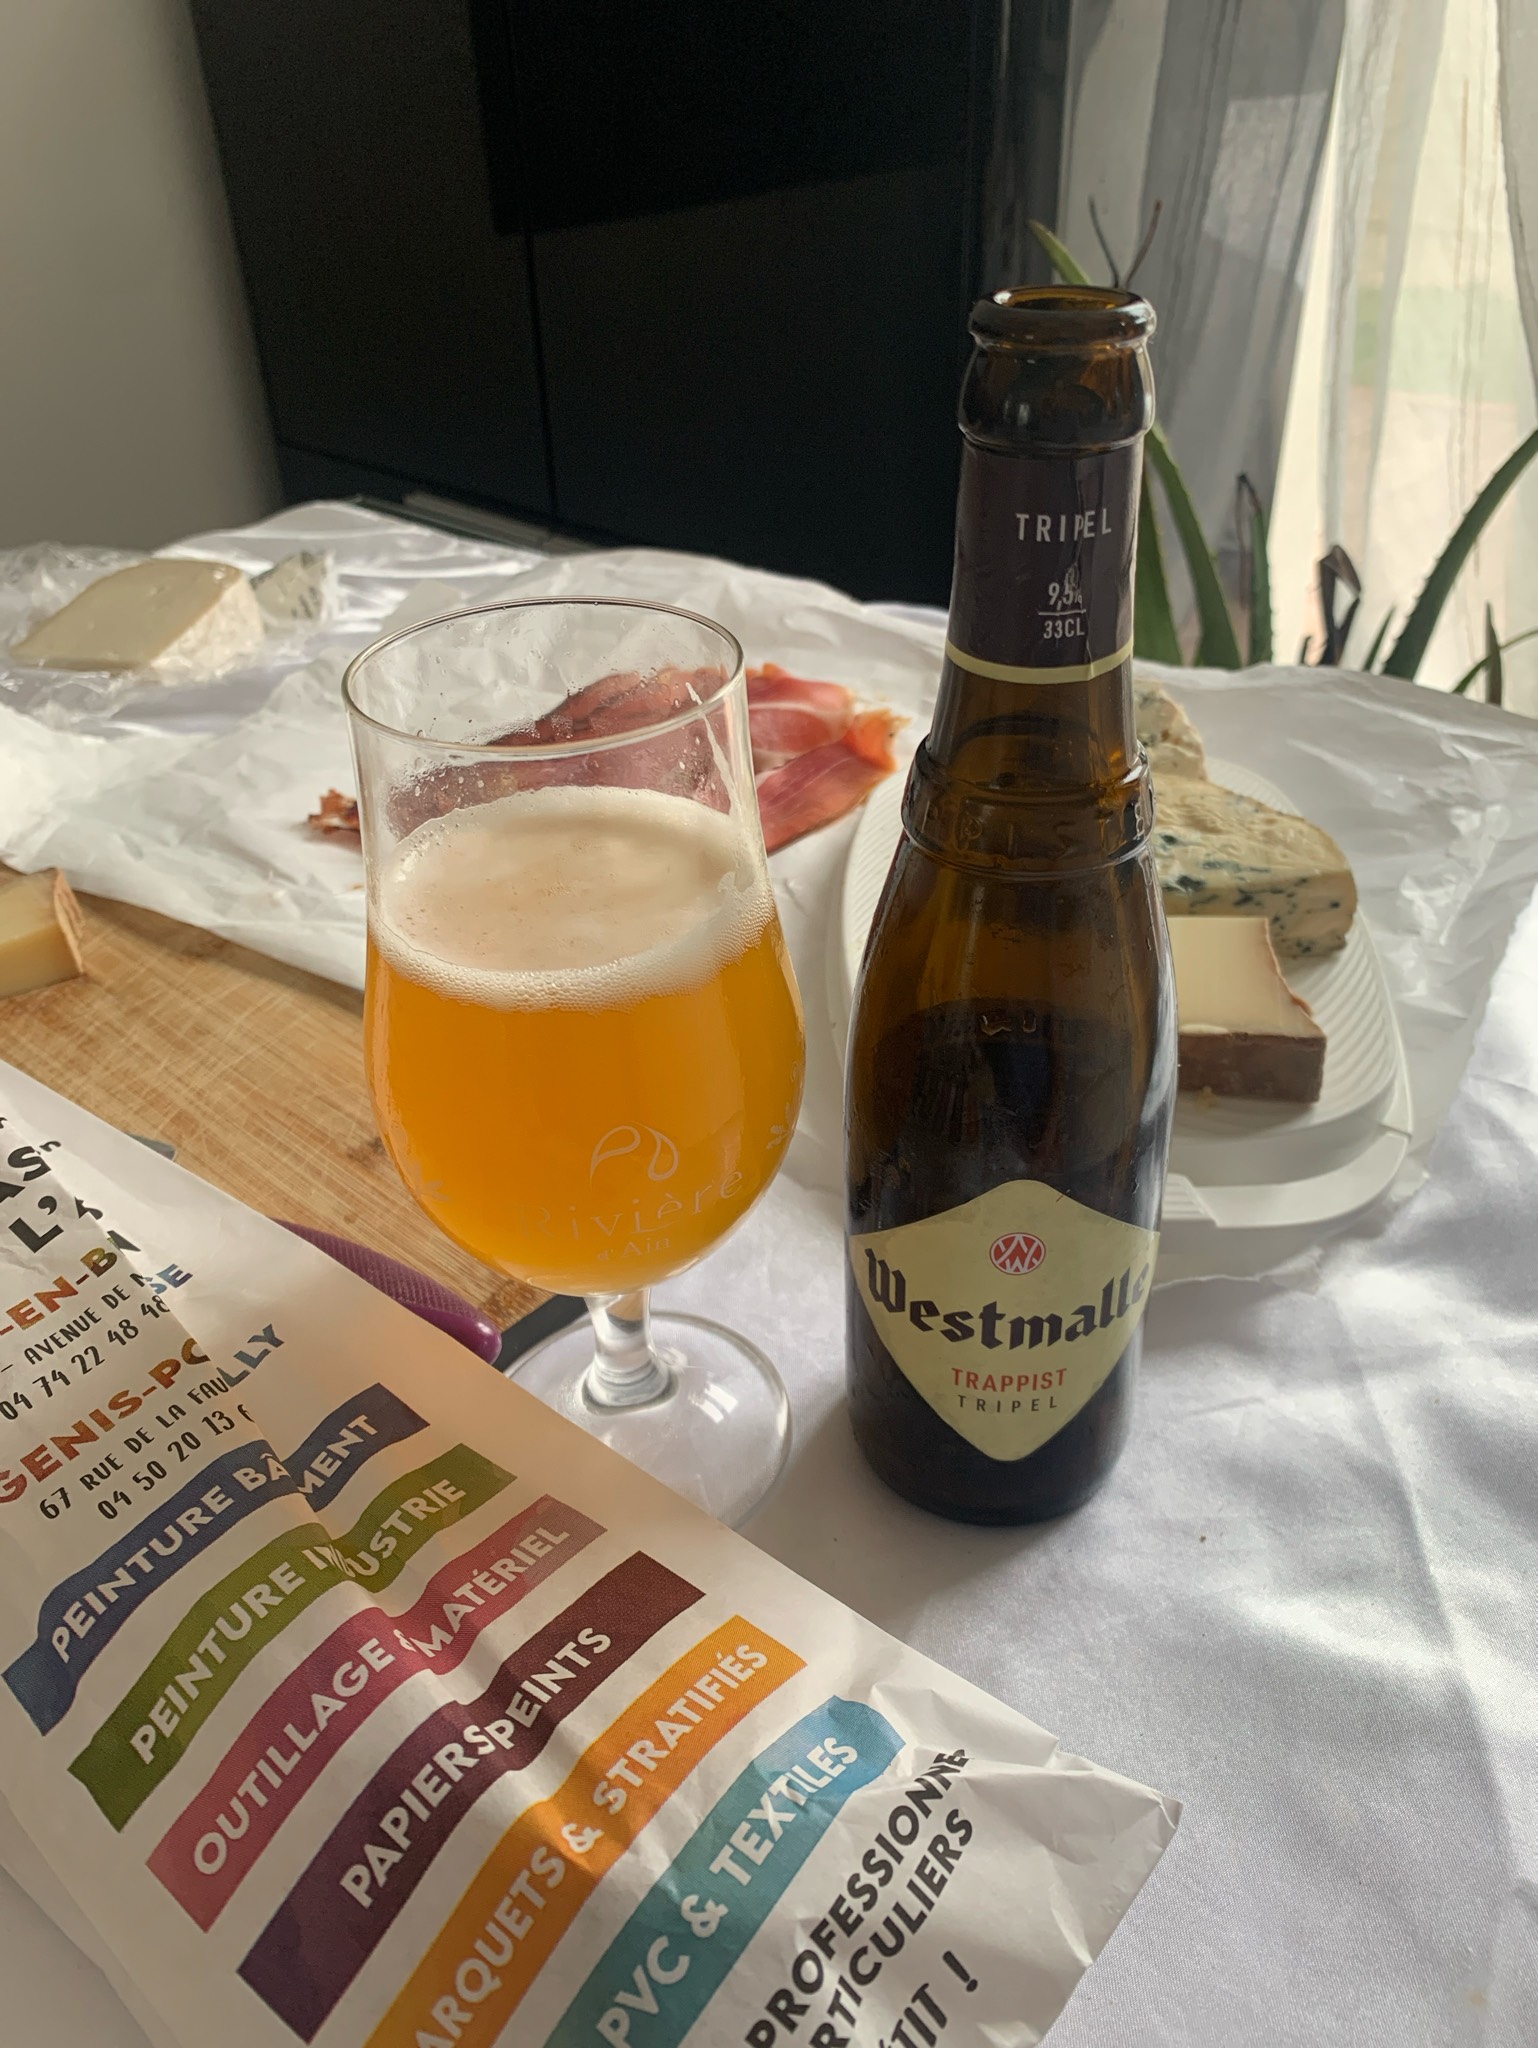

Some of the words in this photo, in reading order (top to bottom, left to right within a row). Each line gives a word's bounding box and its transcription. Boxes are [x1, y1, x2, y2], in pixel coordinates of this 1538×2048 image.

[1015, 508, 1112, 543] TRIPEL
[1043, 618, 1085, 639] 33CL
[520, 1170, 744, 1241] Rivière
[0, 1391, 33, 1421] 04
[32, 1369, 71, 1398] 74
[71, 1345, 105, 1375] 22
[107, 1319, 139, 1346] 48
[140, 1295, 170, 1320] 48
[24, 1307, 102, 1365] AVENUE
[101, 1284, 130, 1309] DE
[864, 1247, 1151, 1351] Westmalle
[951, 1367, 1067, 1393] TRAPPIST
[957, 1395, 1058, 1413] TRIPEL
[39, 1486, 72, 1519] 67
[80, 1453, 124, 1491] RUE
[124, 1427, 155, 1454] DE
[156, 1404, 187, 1428] LA
[187, 1376, 229, 1405] FAU
[97, 1490, 132, 1520] 04
[132, 1460, 167, 1491] 50
[167, 1431, 201, 1463] 20
[202, 1409, 235, 1436] 13
[52, 1484, 236, 1664] PEINTURE
[129, 1561, 306, 1765] PEINTURE
[193, 1636, 397, 1875] OUTILLAGE
[409, 1524, 570, 1658] MATÉRIEL
[340, 1722, 496, 1910] PAPIERS
[479, 1626, 613, 1751] PEINTS
[415, 1846, 566, 2048] ARQUETS
[561, 1823, 605, 1854] &
[593, 1643, 769, 1816] STRATIFIÉS
[595, 1935, 691, 2048] PVC
[681, 1894, 729, 1939] &
[709, 1736, 858, 1888] TEXTILES
[744, 1749, 971, 2048] PROFESSIONNE
[808, 1808, 973, 2048] RTICULIERS
